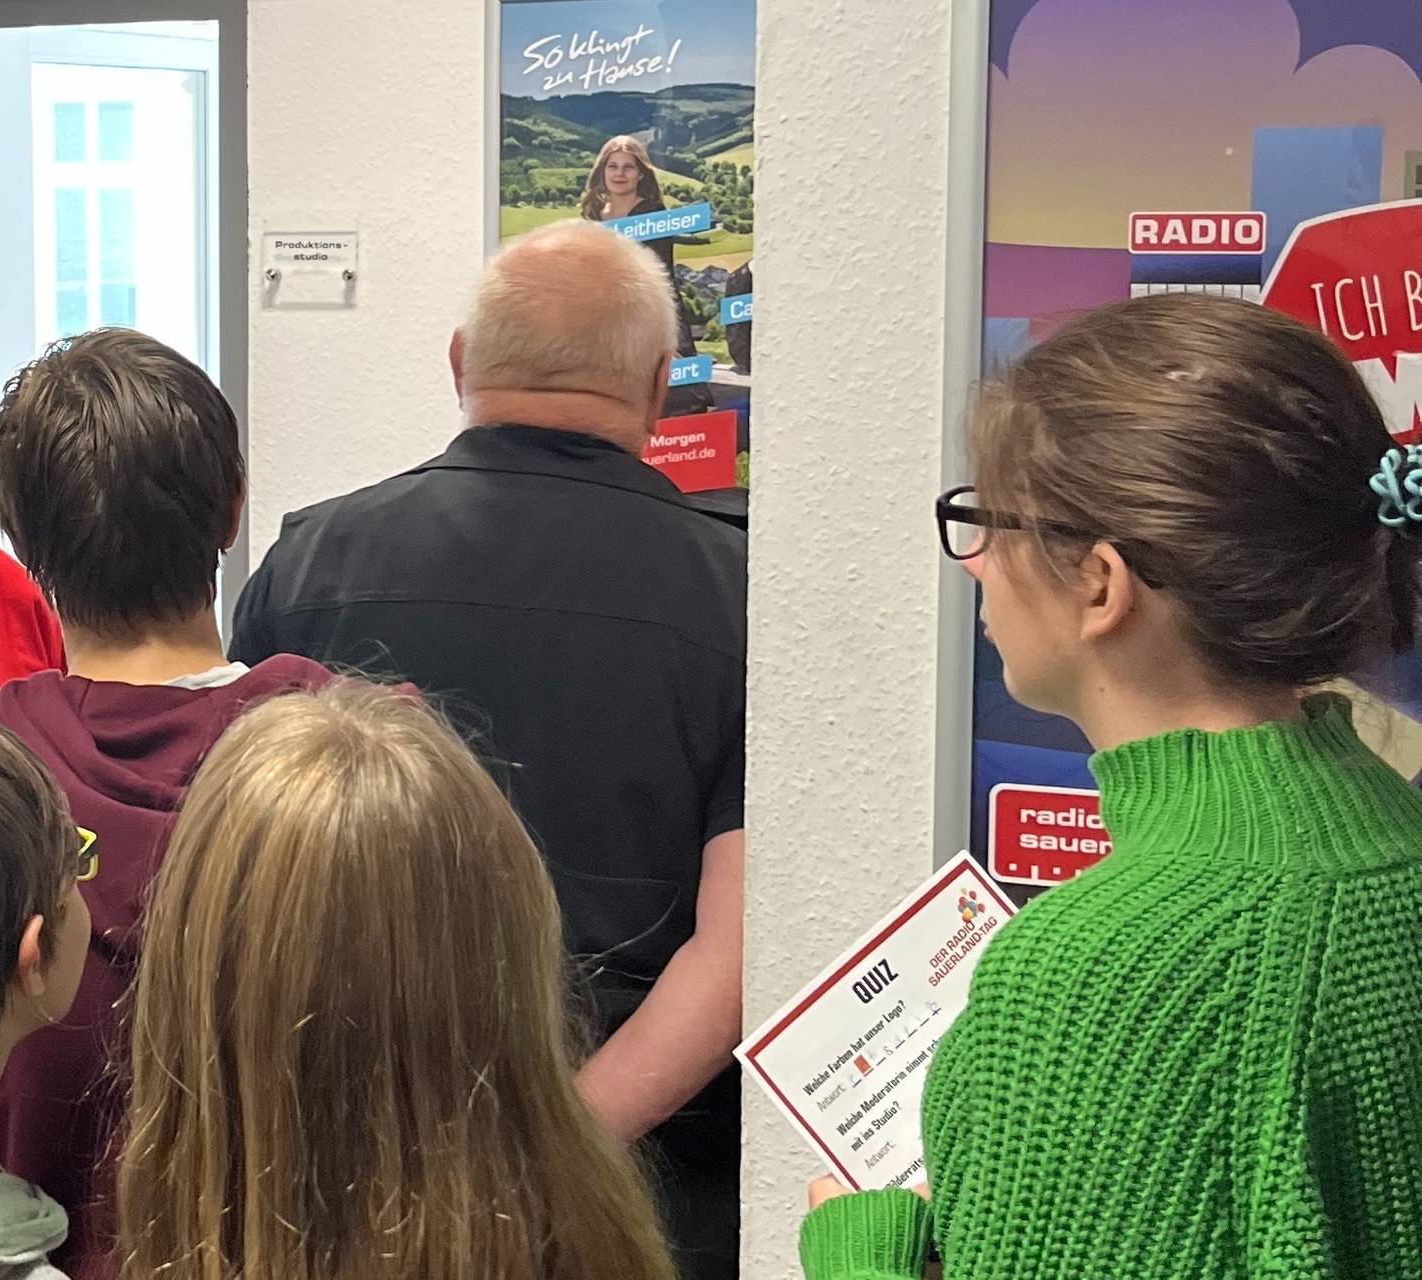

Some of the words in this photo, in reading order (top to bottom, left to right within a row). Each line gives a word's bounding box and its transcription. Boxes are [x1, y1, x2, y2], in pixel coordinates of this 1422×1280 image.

[522, 34, 564, 75] So
[569, 24, 654, 64] klingt
[543, 72, 574, 91] zu
[579, 39, 681, 90] Hause!
[293, 252, 328, 261] studio
[1134, 218, 1260, 245] RADIO
[1310, 274, 1388, 341] ICH
[650, 432, 706, 448] Morgen
[1019, 807, 1105, 829] radio
[928, 916, 998, 987] SAUERLAND-TAG
[929, 947, 949, 968] DER
[946, 920, 976, 951] RADIO
[852, 958, 899, 1004] QUIZ
[802, 1070, 831, 1096] Welche
[827, 1050, 854, 1073] Farben
[849, 1037, 866, 1053] hat
[864, 1020, 884, 1041] unser
[882, 999, 906, 1023] Logo?
[835, 1110, 864, 1136] Welche
[859, 1071, 908, 1113] Moderatorin
[851, 1137, 864, 1152] mit
[860, 1127, 875, 1141] ins
[871, 1100, 901, 1131] Studio?
